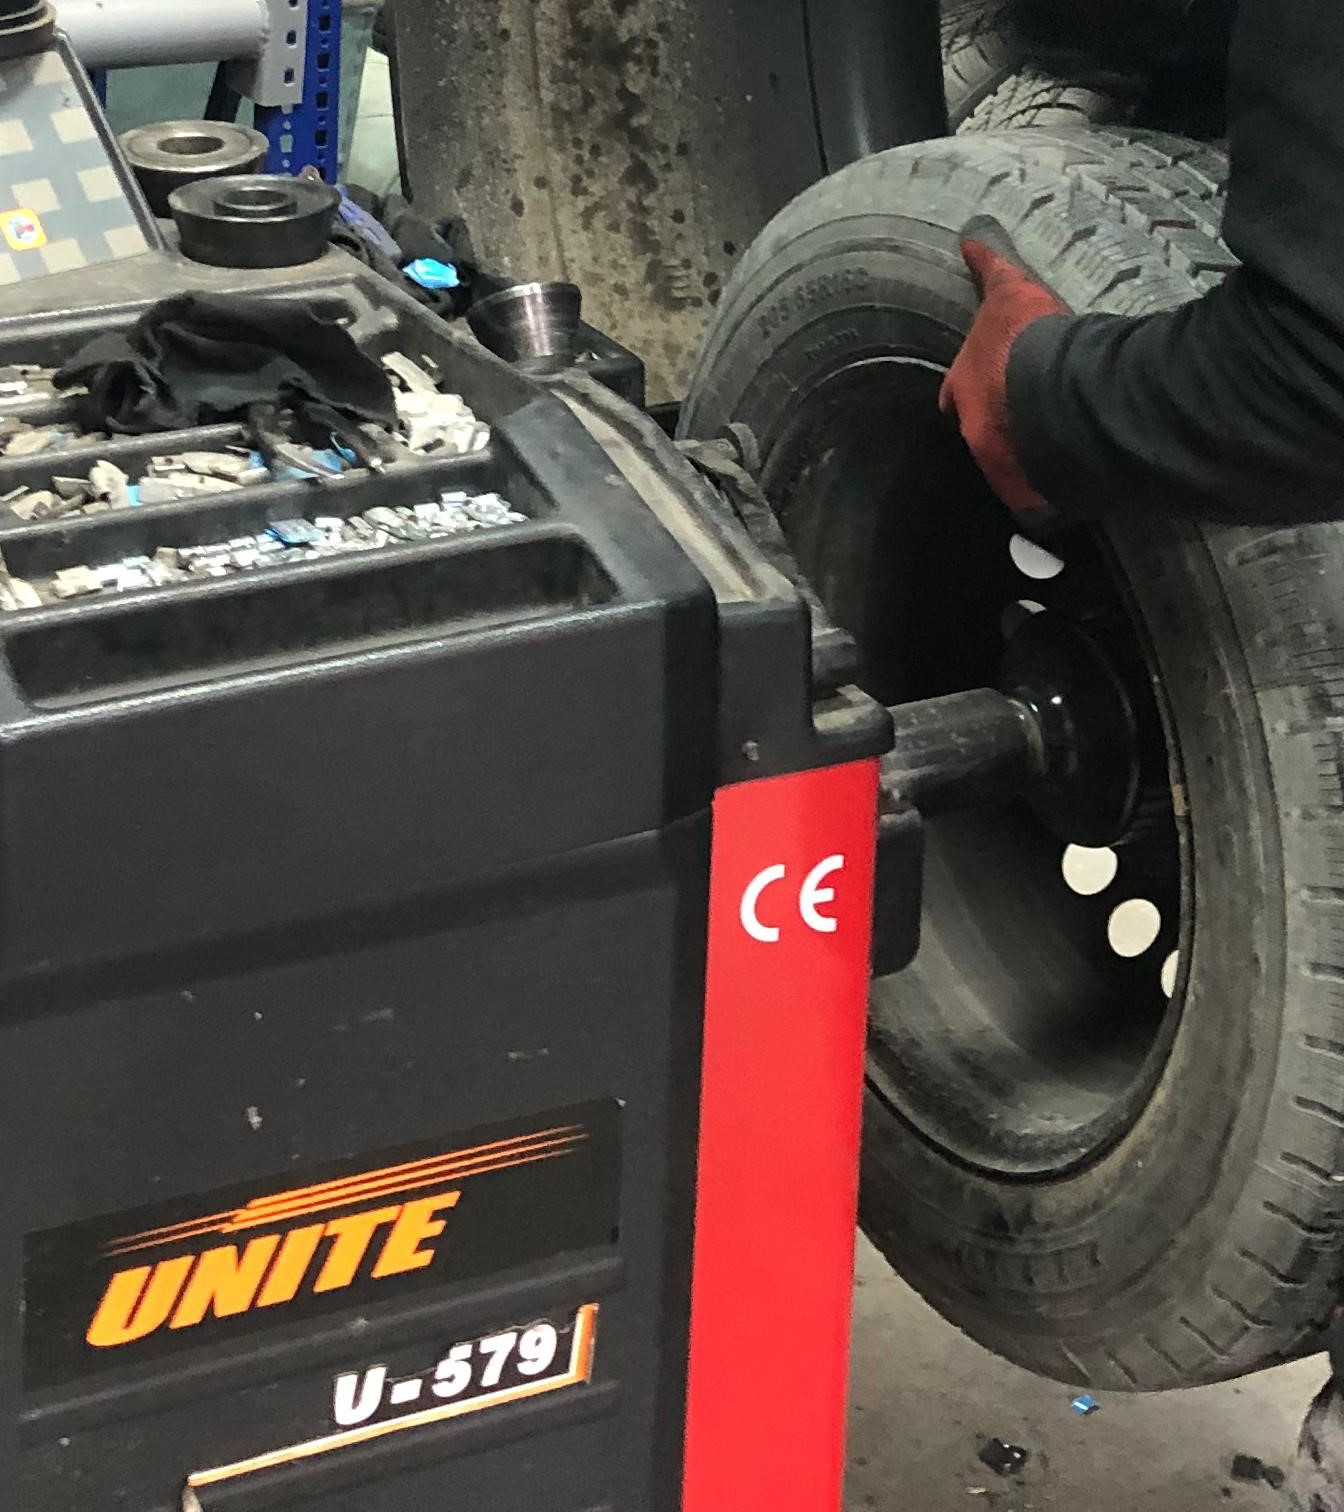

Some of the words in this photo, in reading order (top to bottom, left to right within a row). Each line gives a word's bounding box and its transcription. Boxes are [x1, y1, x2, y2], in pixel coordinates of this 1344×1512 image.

[739, 854, 845, 942] CE
[85, 1189, 462, 1348] UNITE
[332, 1322, 558, 1426] U-579
